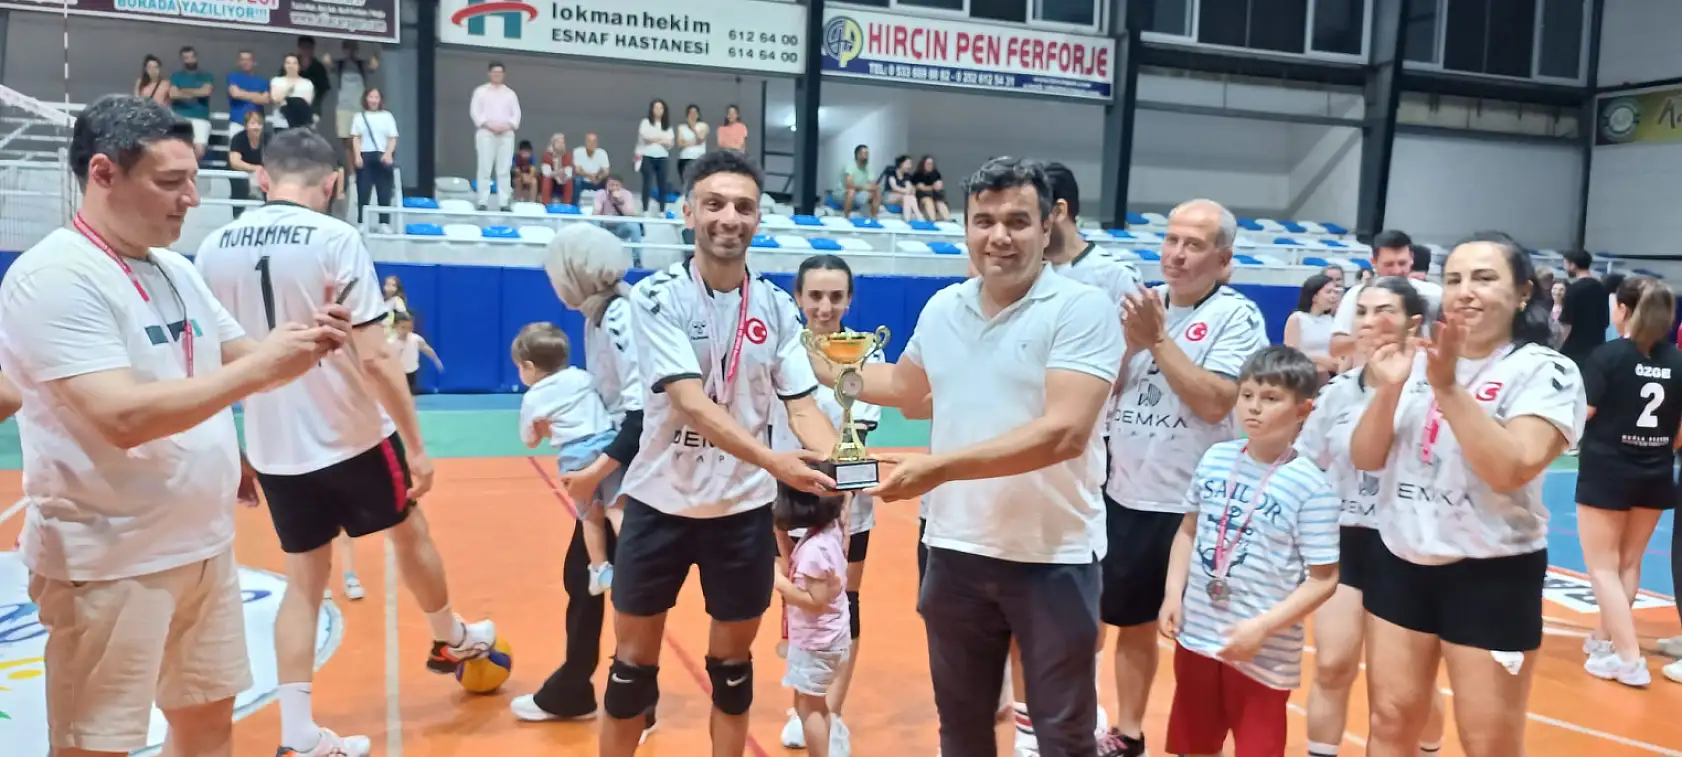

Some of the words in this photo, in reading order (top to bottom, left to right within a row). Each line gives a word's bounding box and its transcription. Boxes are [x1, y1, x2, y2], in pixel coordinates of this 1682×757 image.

[552, 28, 610, 45] ESNAF
[728, 30, 755, 42] 612
[759, 32, 776, 43] 64
[781, 34, 798, 46] 00
[728, 46, 754, 58] 614
[780, 51, 798, 63] 00
[956, 31, 1001, 65] PEN
[1006, 36, 1108, 76] FERFORJE
[219, 225, 318, 248] MUHAMMET
[254, 255, 277, 331] 1
[1636, 382, 1665, 428] 2
[673, 429, 716, 449] DEM
